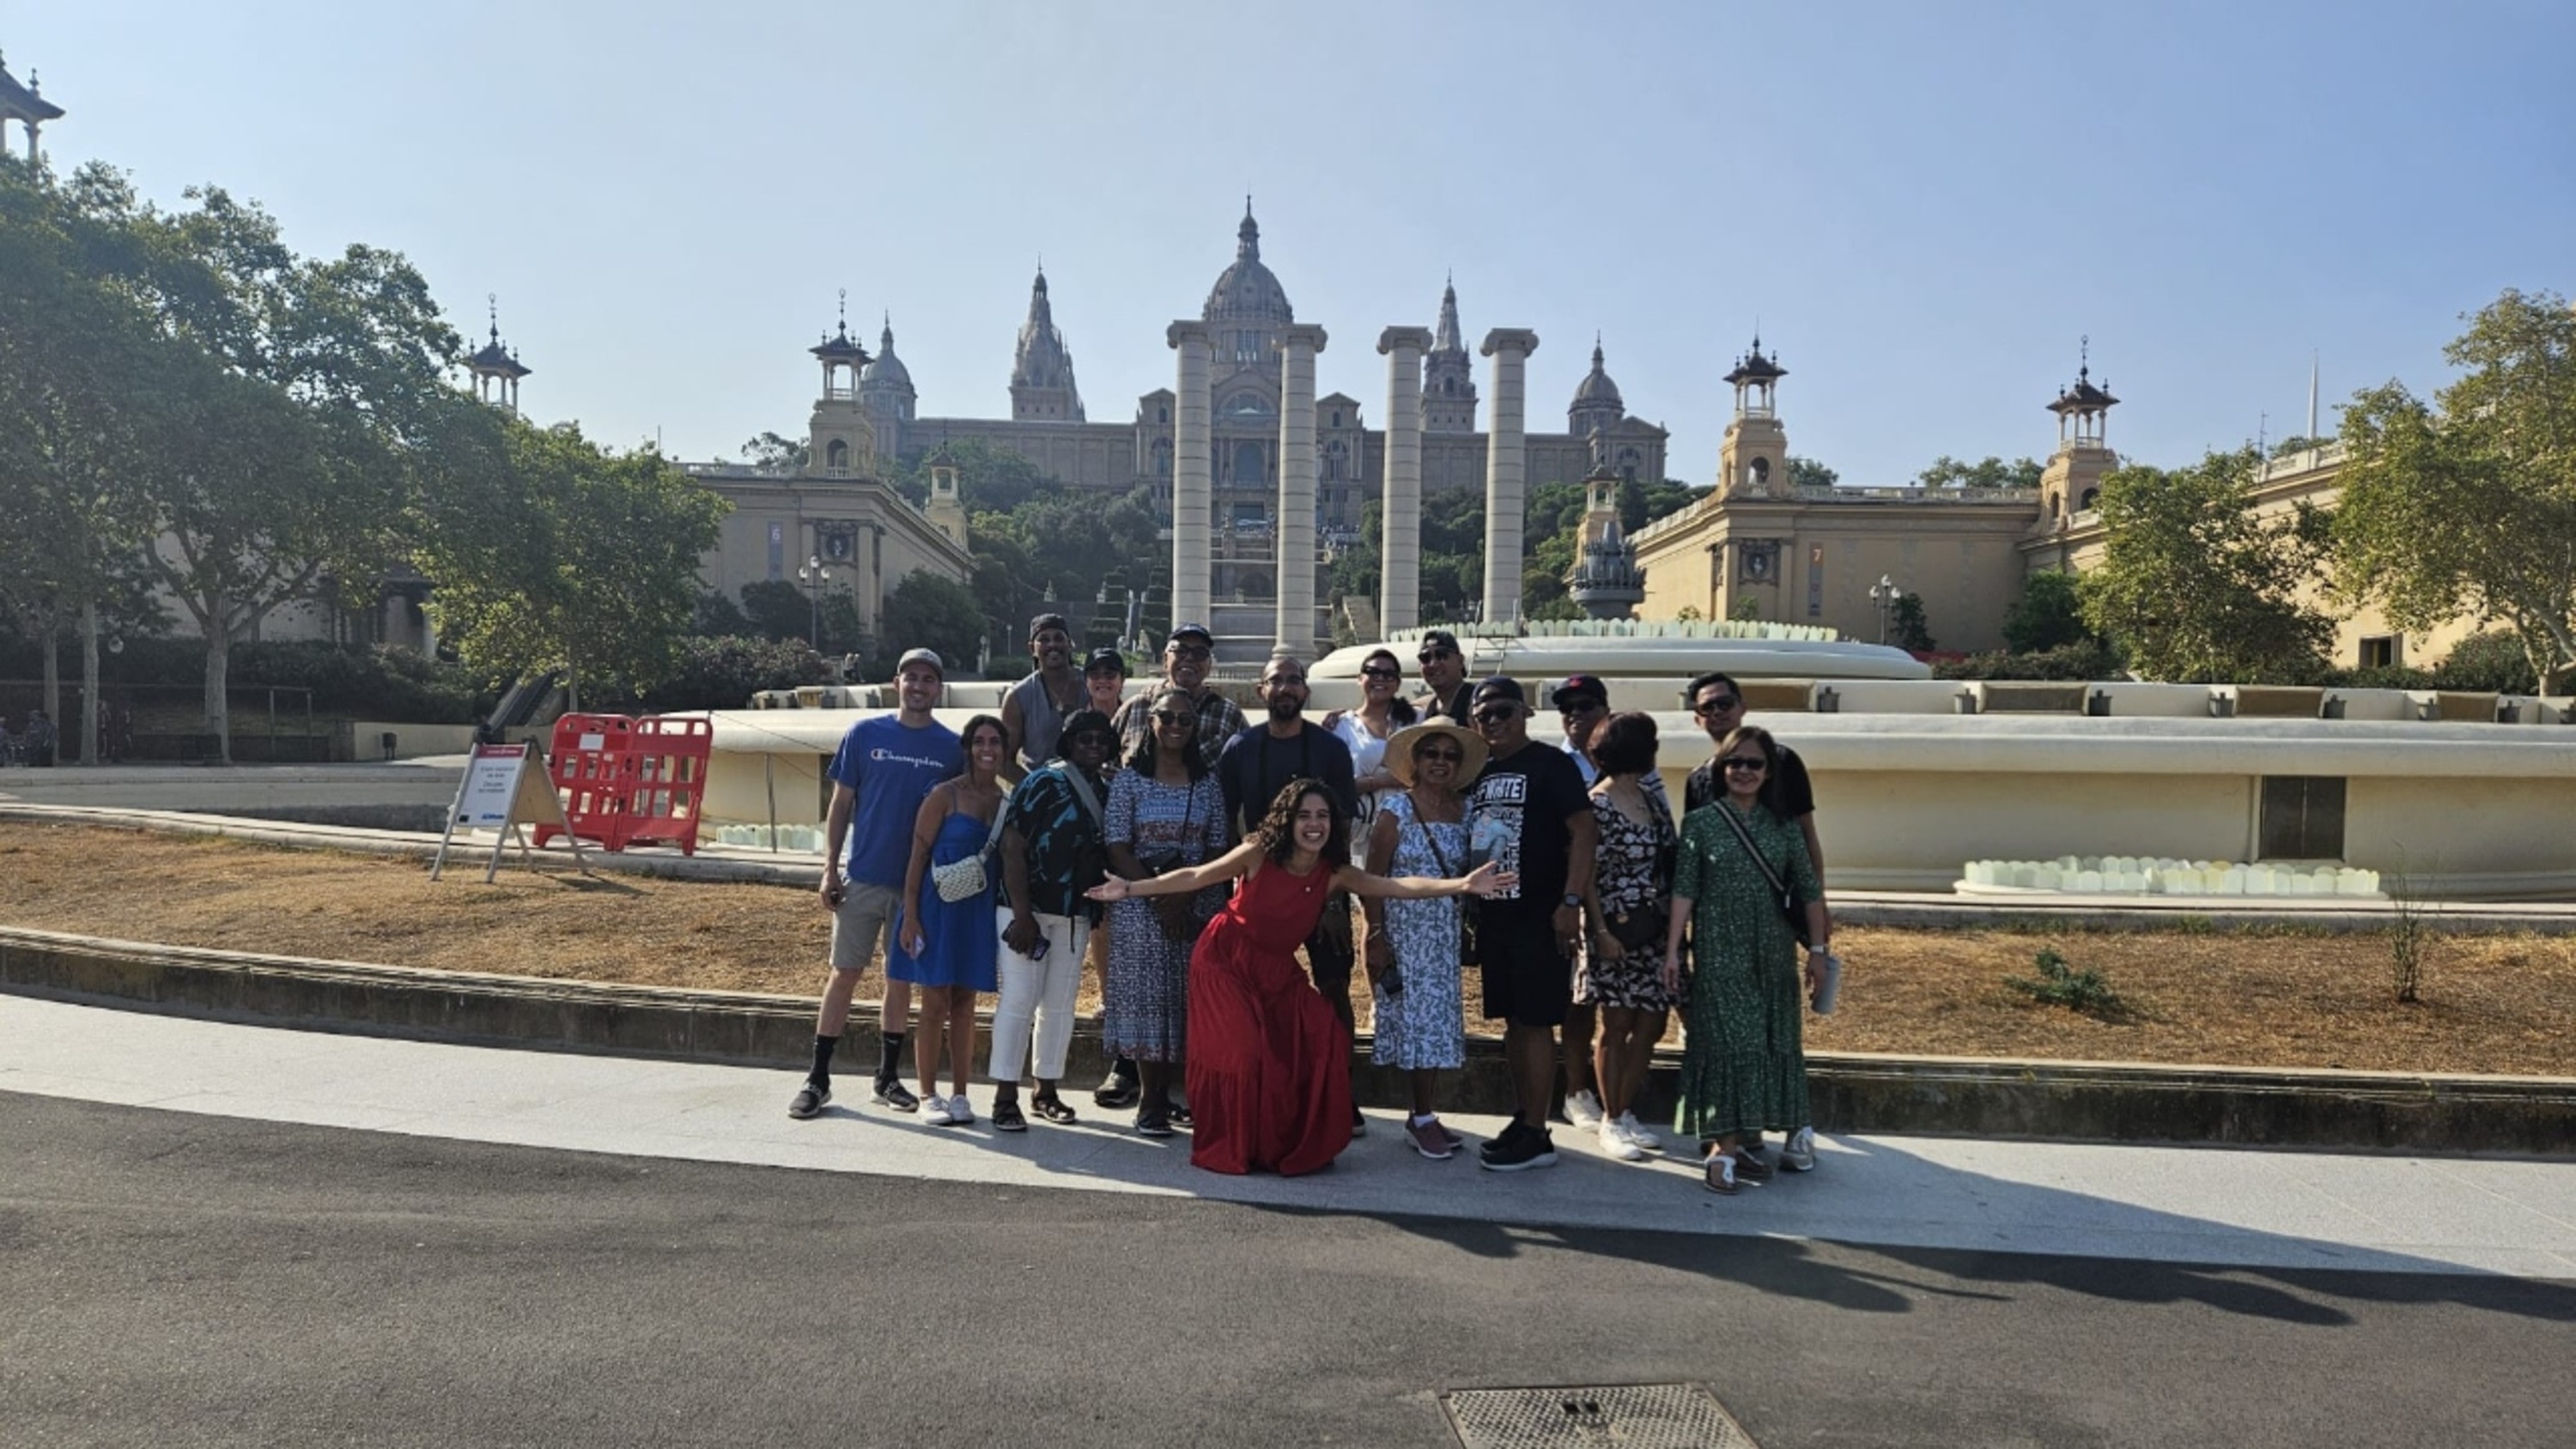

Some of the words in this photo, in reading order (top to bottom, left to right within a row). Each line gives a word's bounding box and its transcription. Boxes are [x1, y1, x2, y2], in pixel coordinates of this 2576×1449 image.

[773, 528, 780, 540] 6
[1814, 549, 1821, 561] 7
[871, 748, 945, 767] Champion
